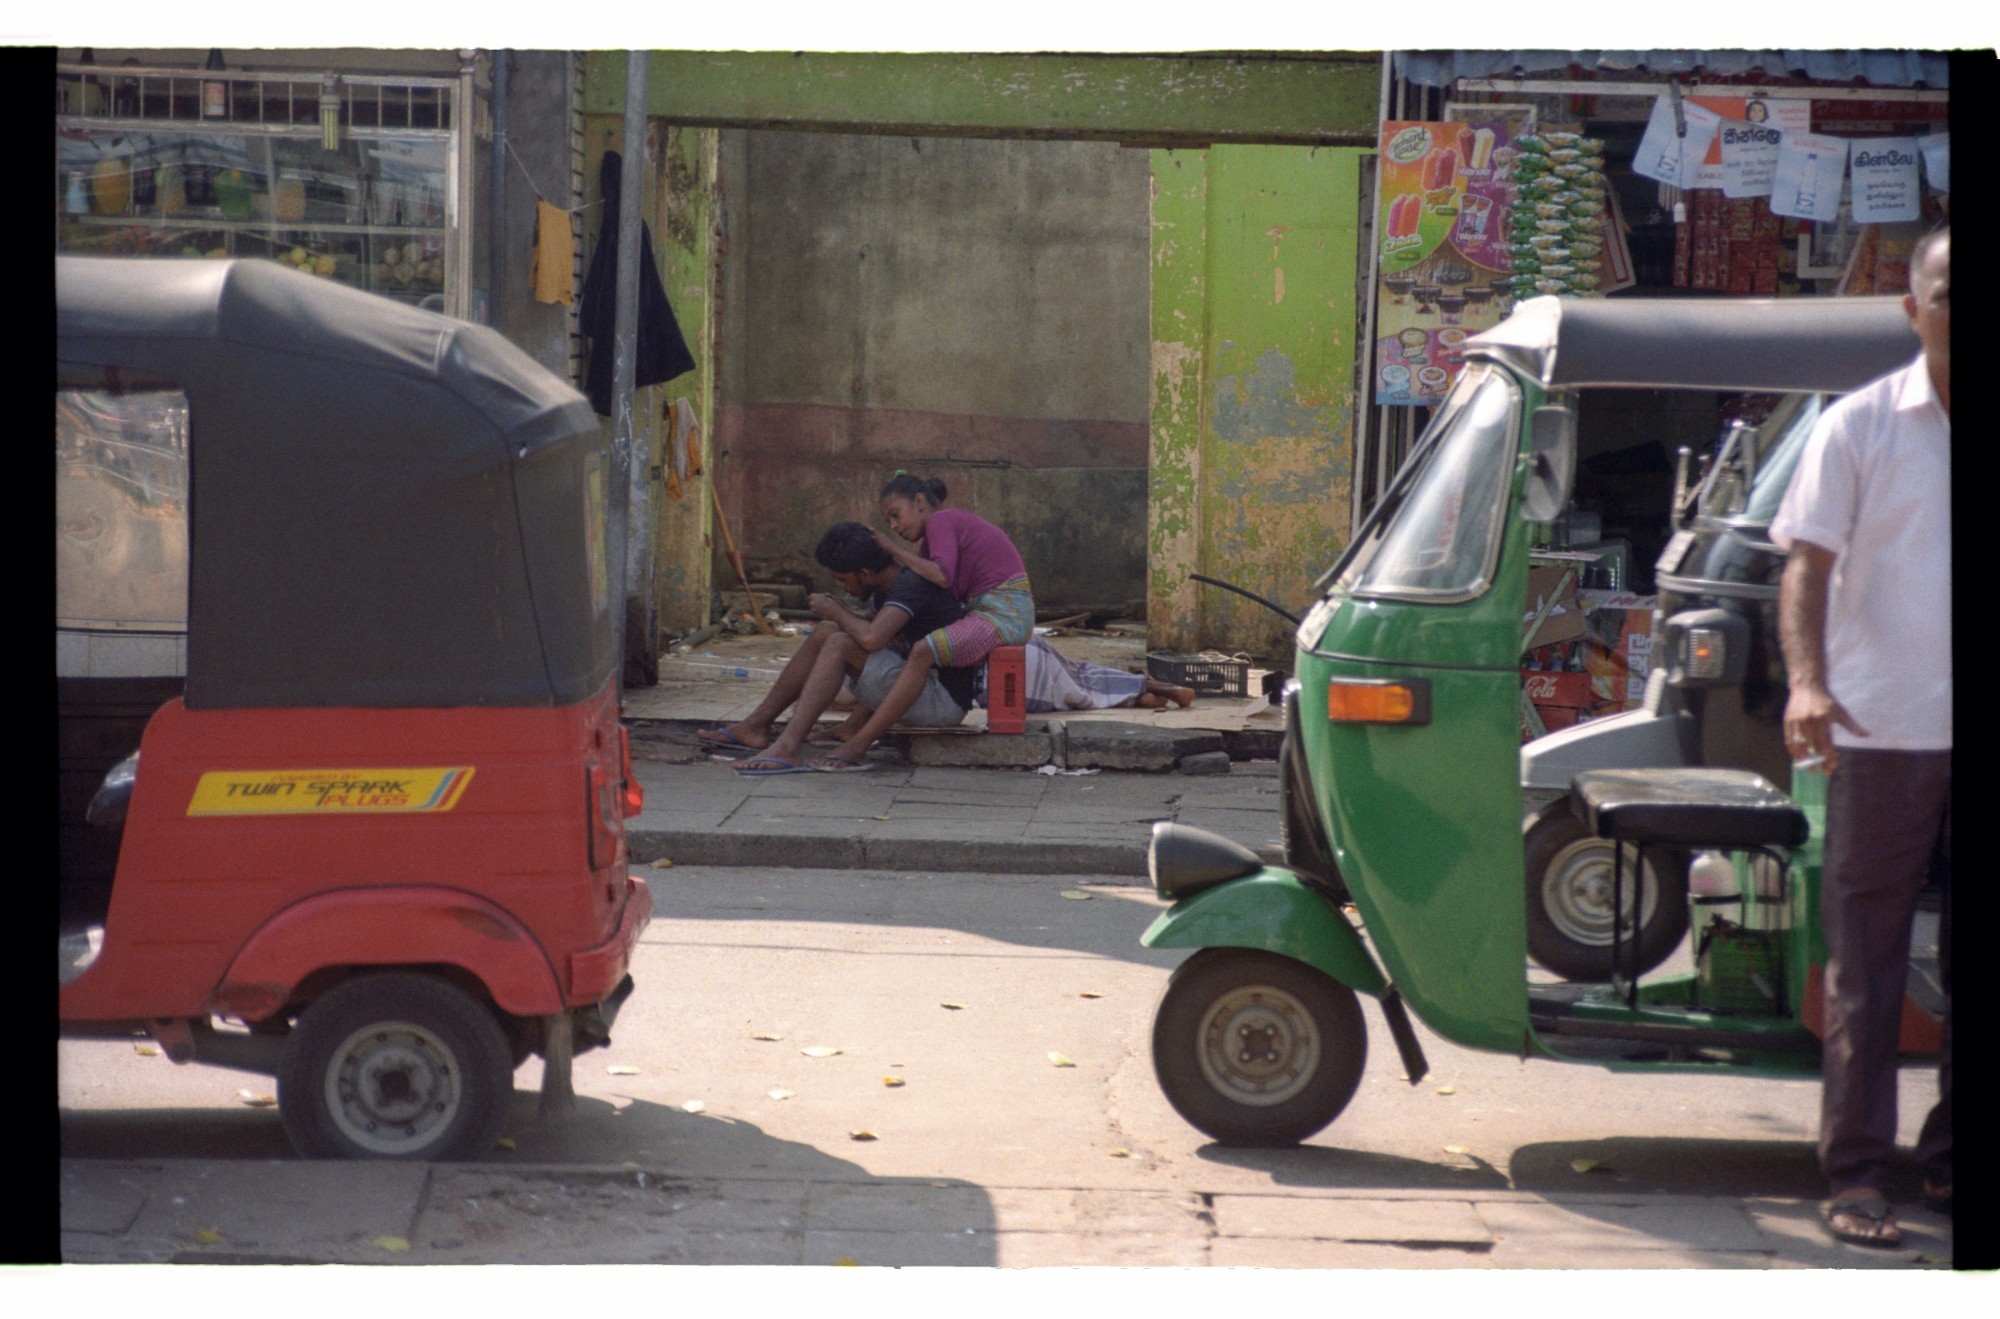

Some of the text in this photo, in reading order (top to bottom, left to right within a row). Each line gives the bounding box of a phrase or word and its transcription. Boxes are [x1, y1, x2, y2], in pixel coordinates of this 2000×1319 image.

[1525, 675, 1559, 698] Cola
[303, 780, 414, 806] SPARK
[323, 794, 411, 807] PLUGS
